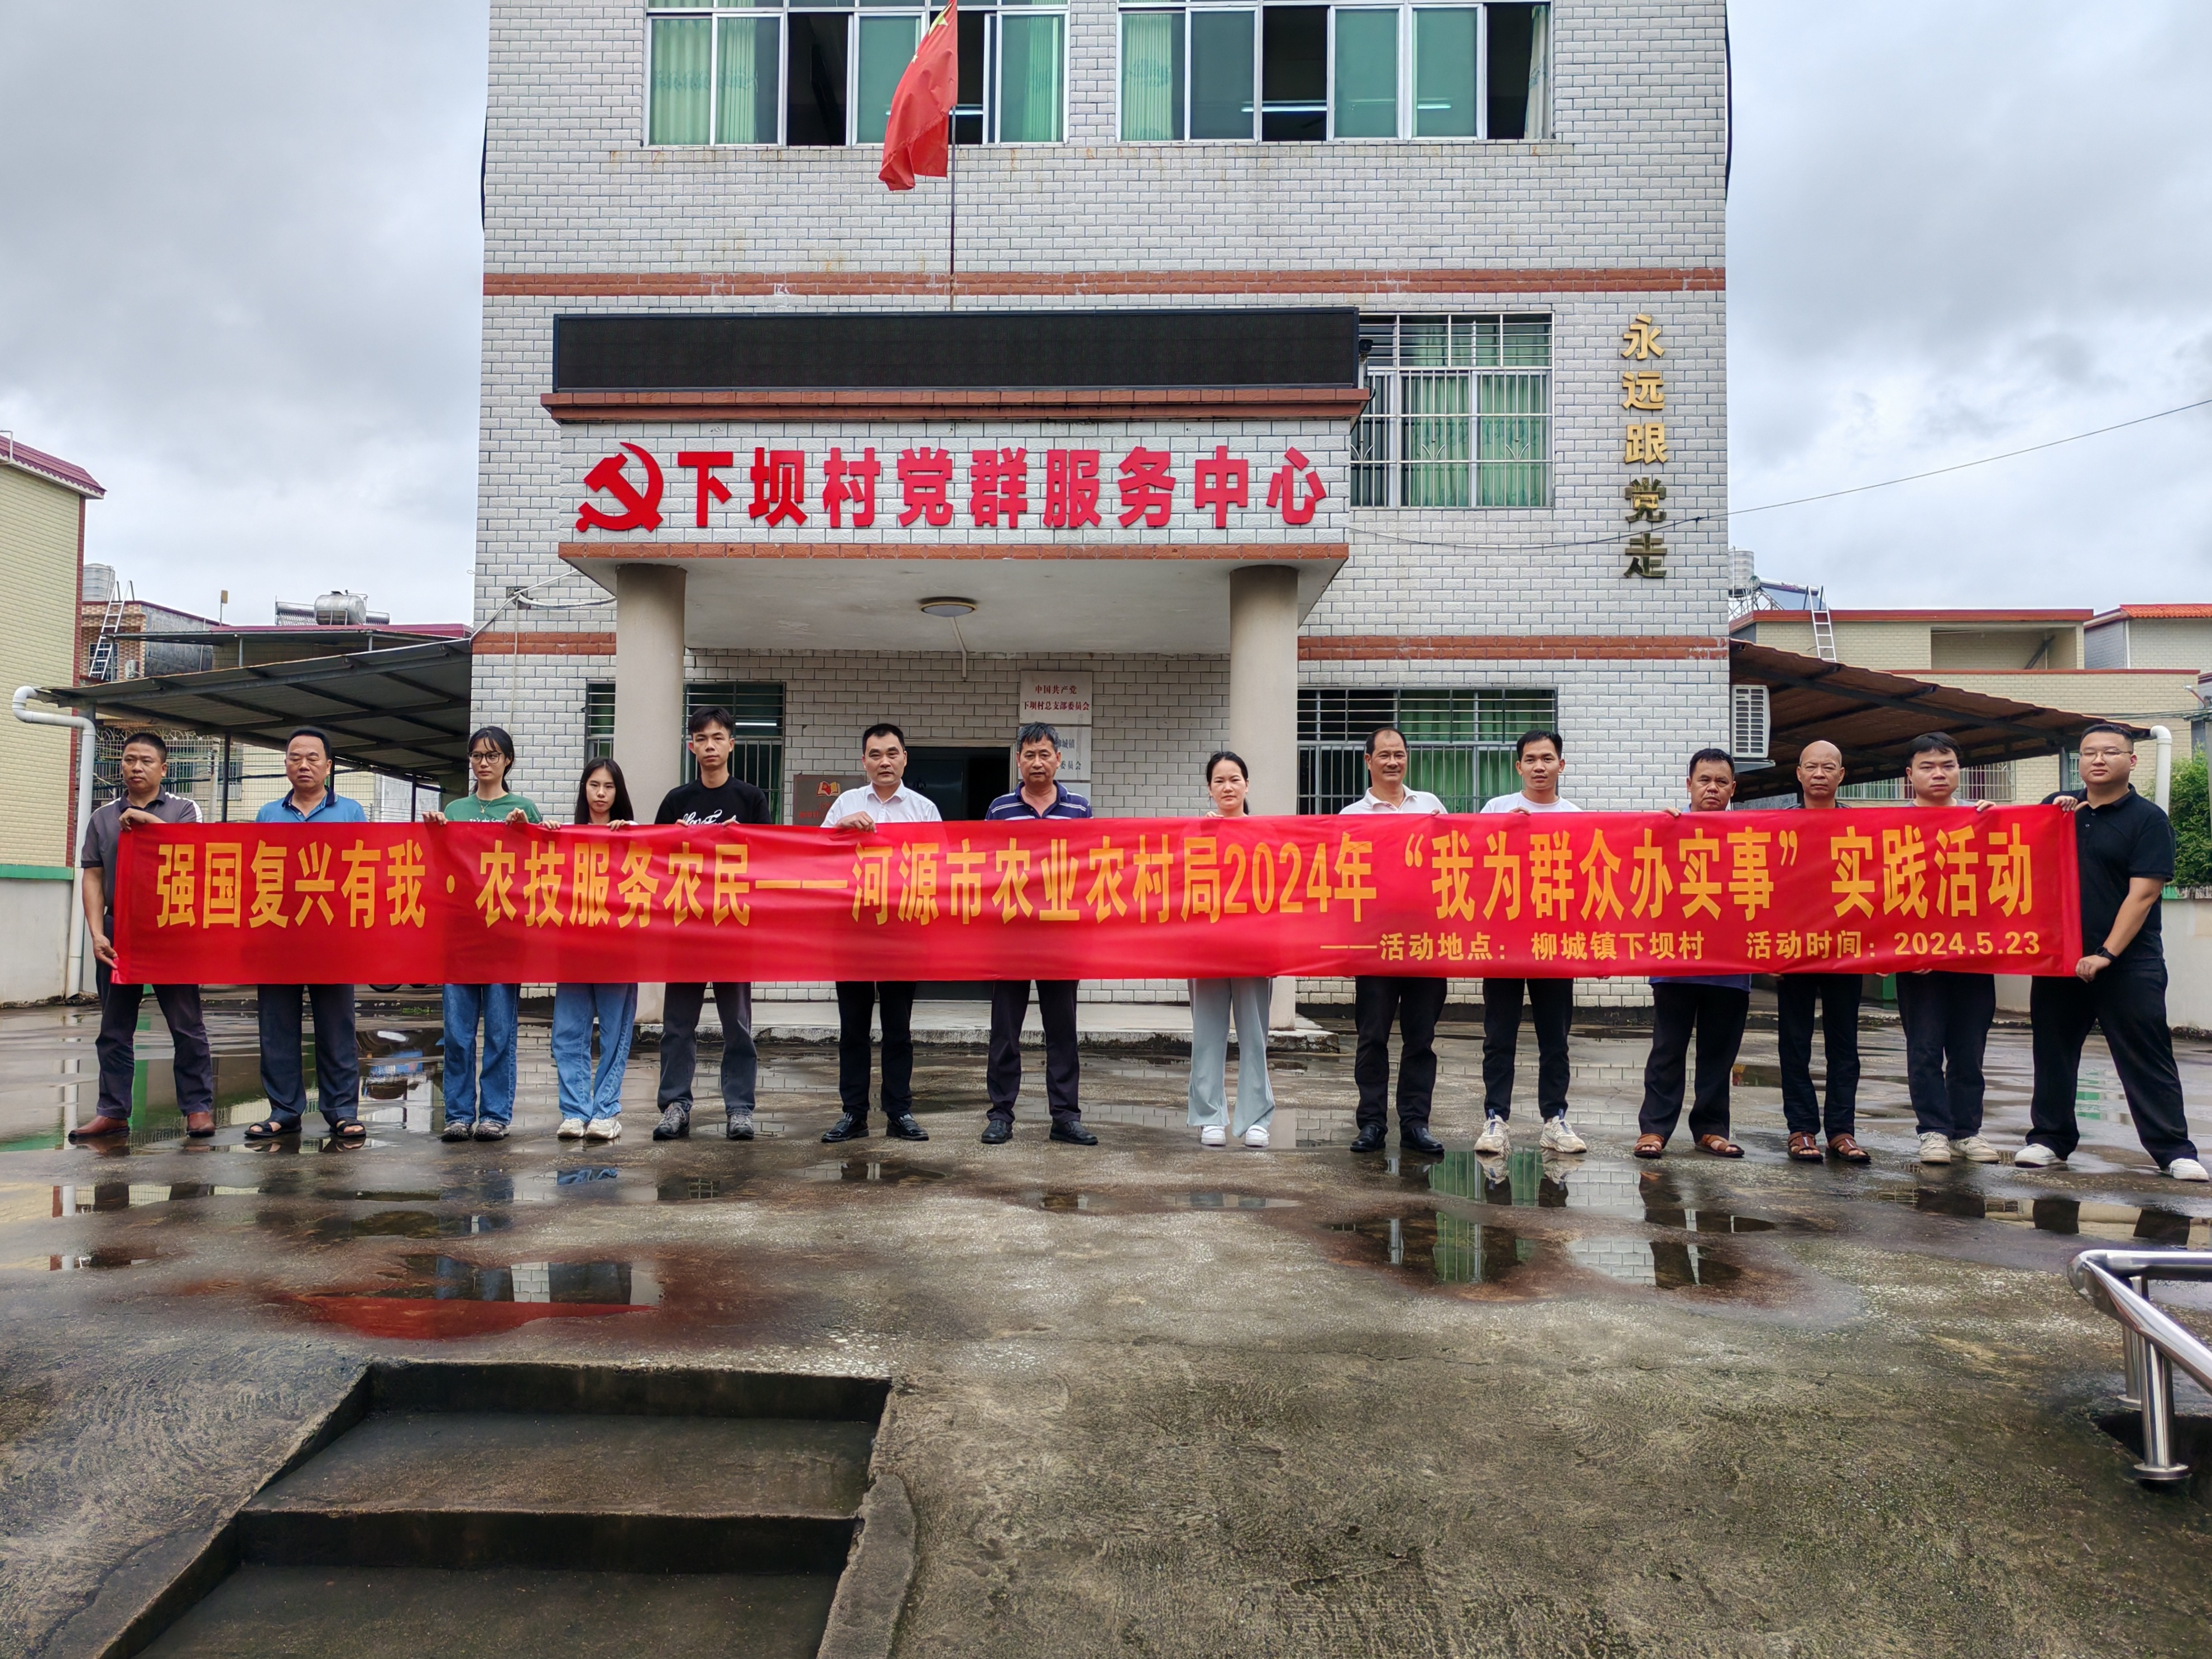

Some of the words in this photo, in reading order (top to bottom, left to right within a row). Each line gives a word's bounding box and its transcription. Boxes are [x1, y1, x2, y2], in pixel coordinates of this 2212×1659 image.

[1621, 313, 1668, 579] 永远跟党走
[676, 445, 1327, 529] 下坝村党群服务中心
[1035, 684, 1077, 694] 中国共产党
[1022, 701, 1090, 711] 下坝村总支部委员会
[1057, 760, 1081, 770] 委员会
